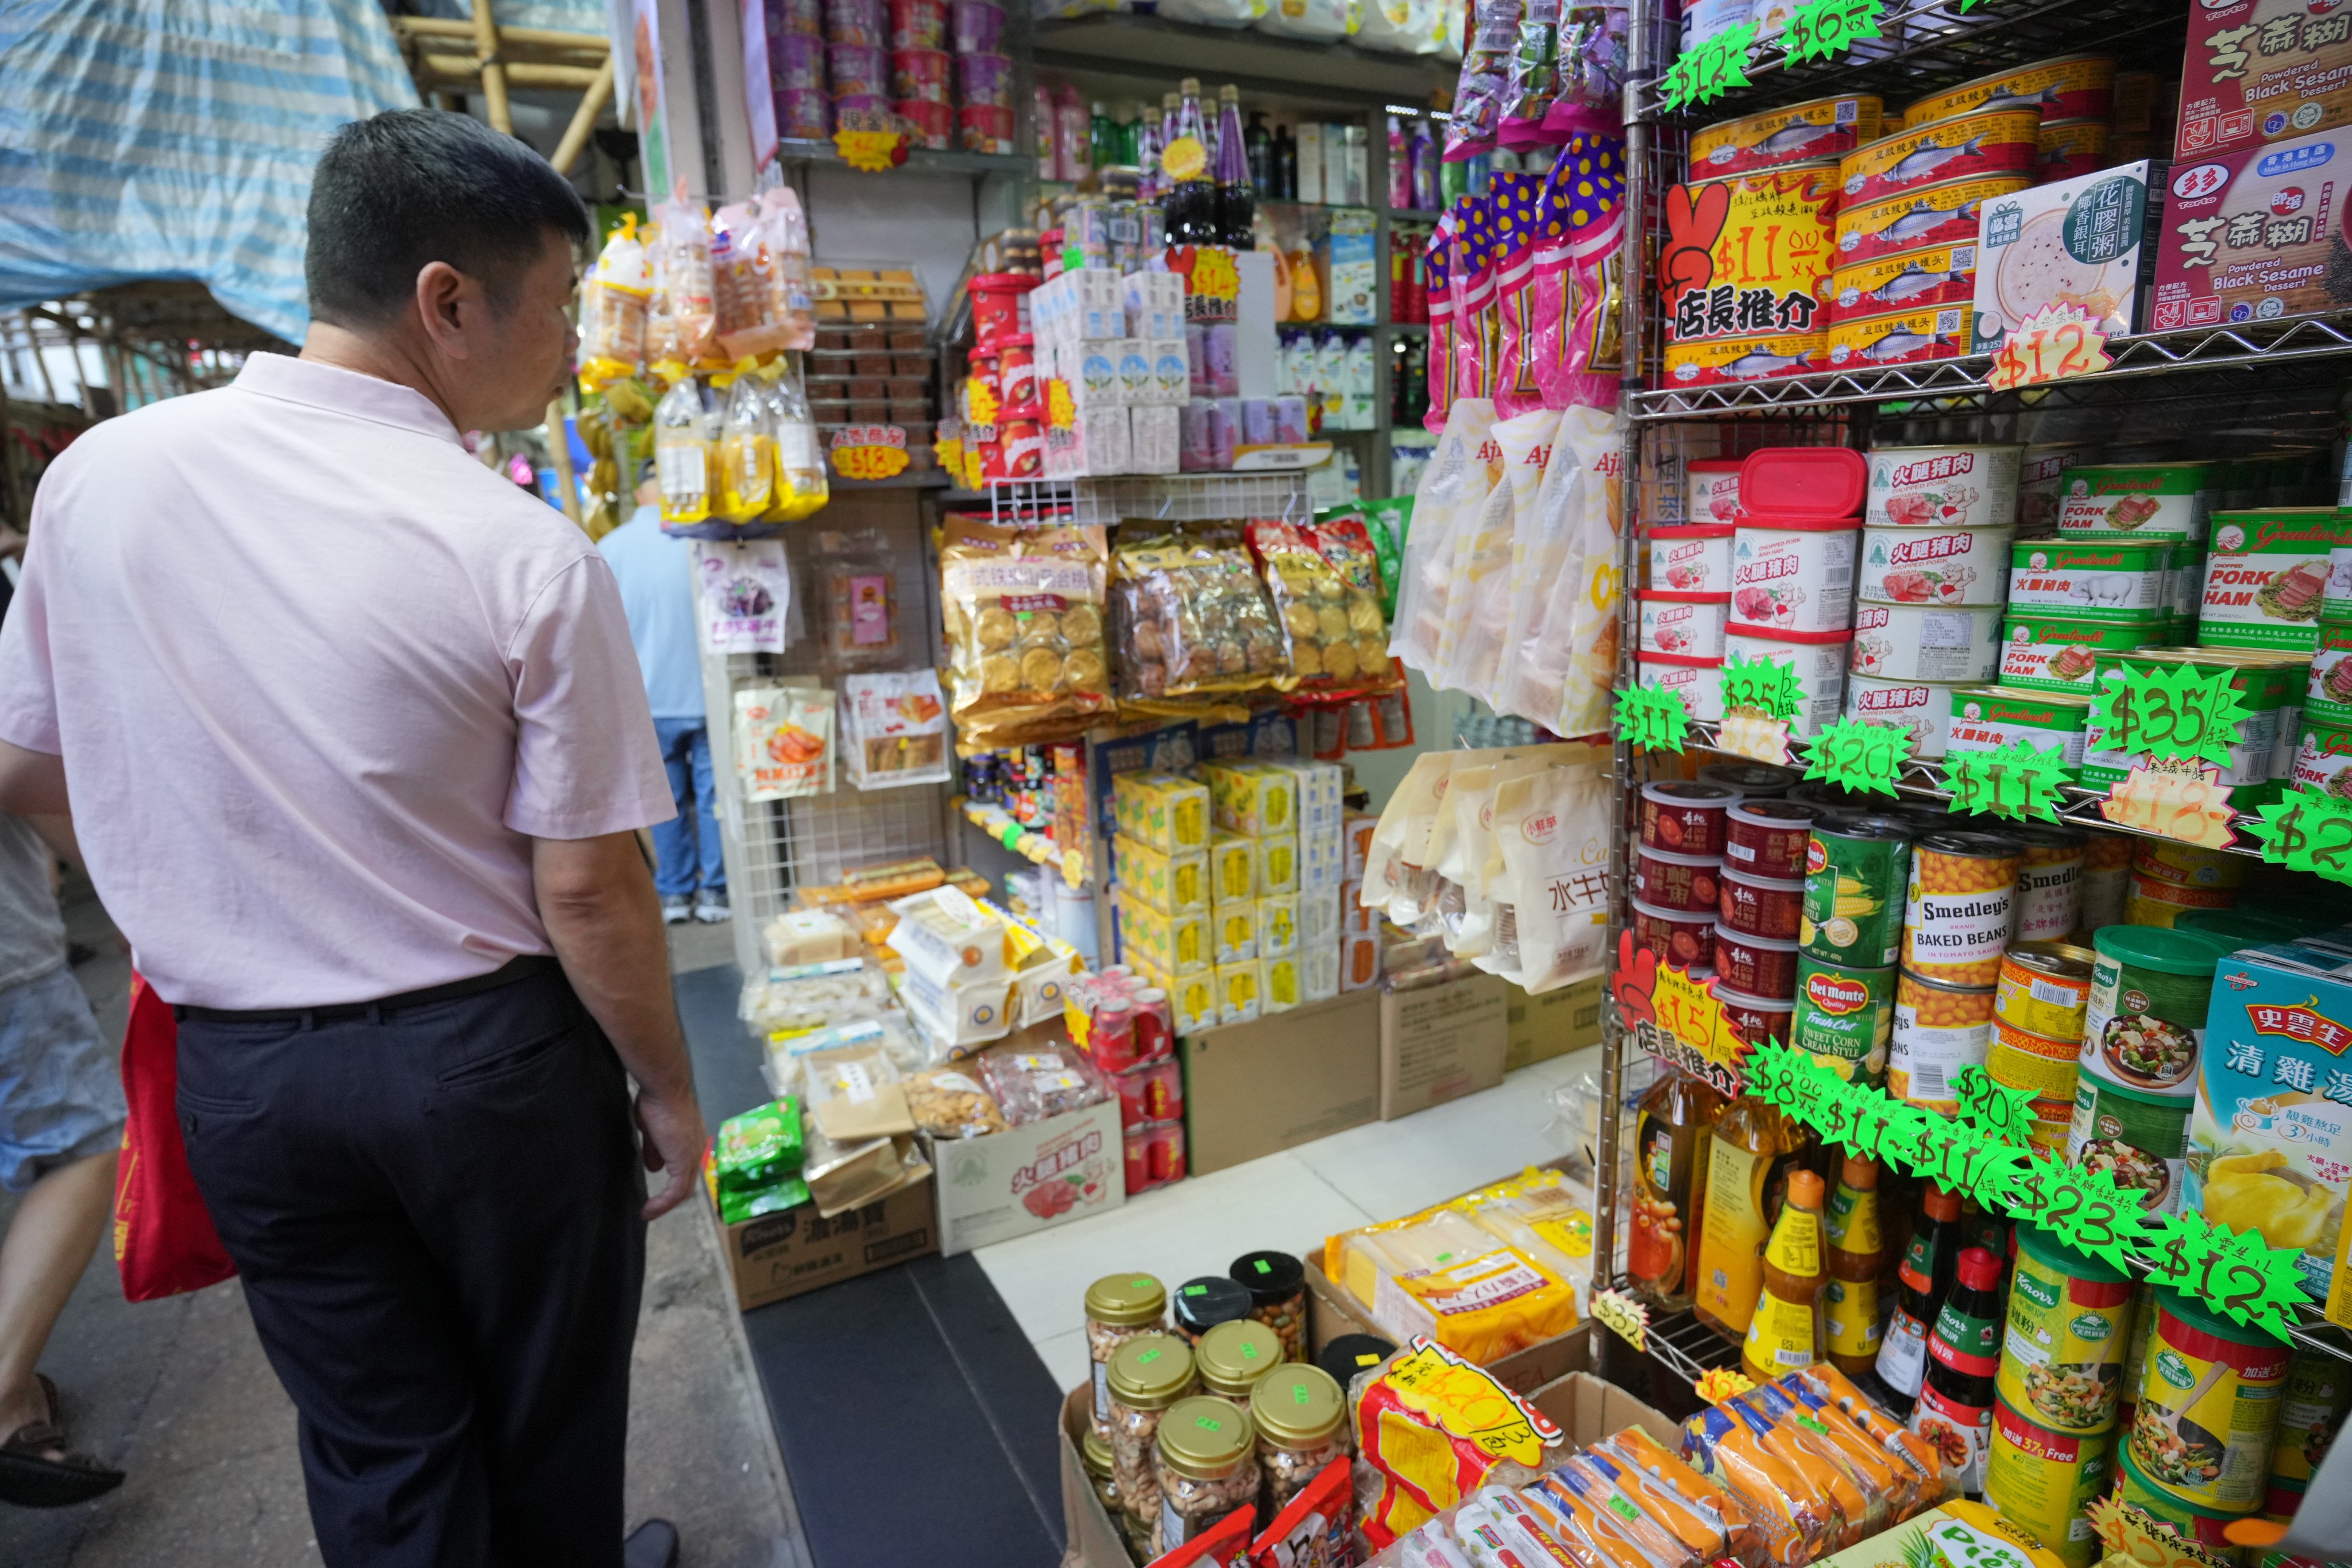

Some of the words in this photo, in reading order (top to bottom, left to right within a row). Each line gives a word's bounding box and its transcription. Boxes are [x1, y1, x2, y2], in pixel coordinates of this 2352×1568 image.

[2206, 3, 2247, 21] Torto
[2261, 59, 2319, 84] Powdered
[2245, 80, 2289, 102] Black
[2300, 79, 2347, 99] Dessert
[2264, 165, 2281, 173] Made
[2291, 160, 2308, 170] Hong
[2309, 156, 2326, 167] Kong
[2267, 144, 2326, 165] 香港製造
[2182, 168, 2216, 196] 多多
[2178, 196, 2216, 209] Torto
[2271, 192, 2303, 209] 即溶
[2073, 195, 2092, 254] 椰香銀耳
[2090, 183, 2121, 258] 花膠粥
[1714, 225, 1782, 284] $11
[2229, 258, 2281, 274] Powdered
[2158, 281, 2187, 291] 方便配方
[2213, 273, 2255, 290] Black
[2258, 265, 2324, 283] Sesame
[2264, 278, 2307, 292] Dessert
[1675, 286, 1817, 339] 店長推介
[1998, 323, 2089, 387] $12
[1893, 453, 1973, 487] 火腿猪肉
[1893, 484, 1925, 493] CHOPPED
[1927, 478, 1949, 488] PORK
[2093, 476, 2164, 497] Greatwall
[2065, 507, 2107, 516] PORK
[2061, 519, 2094, 528] HAM
[1759, 541, 1785, 551] CHOPPED
[1771, 548, 1784, 556] HAM
[1891, 533, 1972, 565] 火腿猪肉
[2210, 551, 2249, 560] Greatwall
[1736, 555, 1799, 585] 火腿猪肉
[1891, 561, 1924, 570] CHOPPED
[2053, 551, 2123, 571] Greatwall
[2209, 570, 2276, 585] PORK
[2203, 592, 2254, 607] HAM
[2036, 625, 2105, 644] Greatwall
[1779, 648, 1793, 656] PORK
[2007, 653, 2049, 664] PORK
[2003, 665, 2036, 675] HAM
[1859, 687, 1929, 710] 火腿猪肉
[1627, 699, 1673, 746] $11
[1986, 704, 2054, 723] Greatwall
[1816, 734, 1894, 779] $20
[1817, 877, 1832, 887] WITH
[1924, 897, 2009, 920] Smedley's
[1917, 929, 1962, 947] BAKED
[1968, 925, 2007, 945] BEANS
[1977, 945, 2000, 956] SAUCE
[2094, 966, 2114, 985] Knorr
[2225, 975, 2256, 986] SWANSON
[1810, 981, 1826, 997] Del
[1828, 987, 1864, 1002] Monte
[1800, 1000, 1813, 1011] MADE
[1822, 998, 1846, 1010] Quality
[1806, 1012, 1833, 1028] Fresh
[1833, 1019, 1860, 1032] Cut
[2257, 1009, 2345, 1047] 史雲生
[1803, 1025, 1830, 1044] SWEET
[1832, 1034, 1861, 1047] CORN
[1802, 1037, 1830, 1054] CREAM
[1832, 1045, 1859, 1057] STYLE
[1635, 1019, 1735, 1096] 店長推介
[2227, 1040, 2352, 1104] 清雞湯
[2286, 1110, 2341, 1136] 靚雞熬足
[2288, 1124, 2299, 1138] 3
[2305, 1133, 2331, 1148] 小時
[2017, 1272, 2054, 1306] Knorr
[1940, 1306, 1967, 1334] Knorr
[2243, 1366, 2269, 1378] 加送
[2003, 1427, 2022, 1446] 加送
[2022, 1436, 2045, 1458] 37g
[2046, 1448, 2074, 1462] Free
